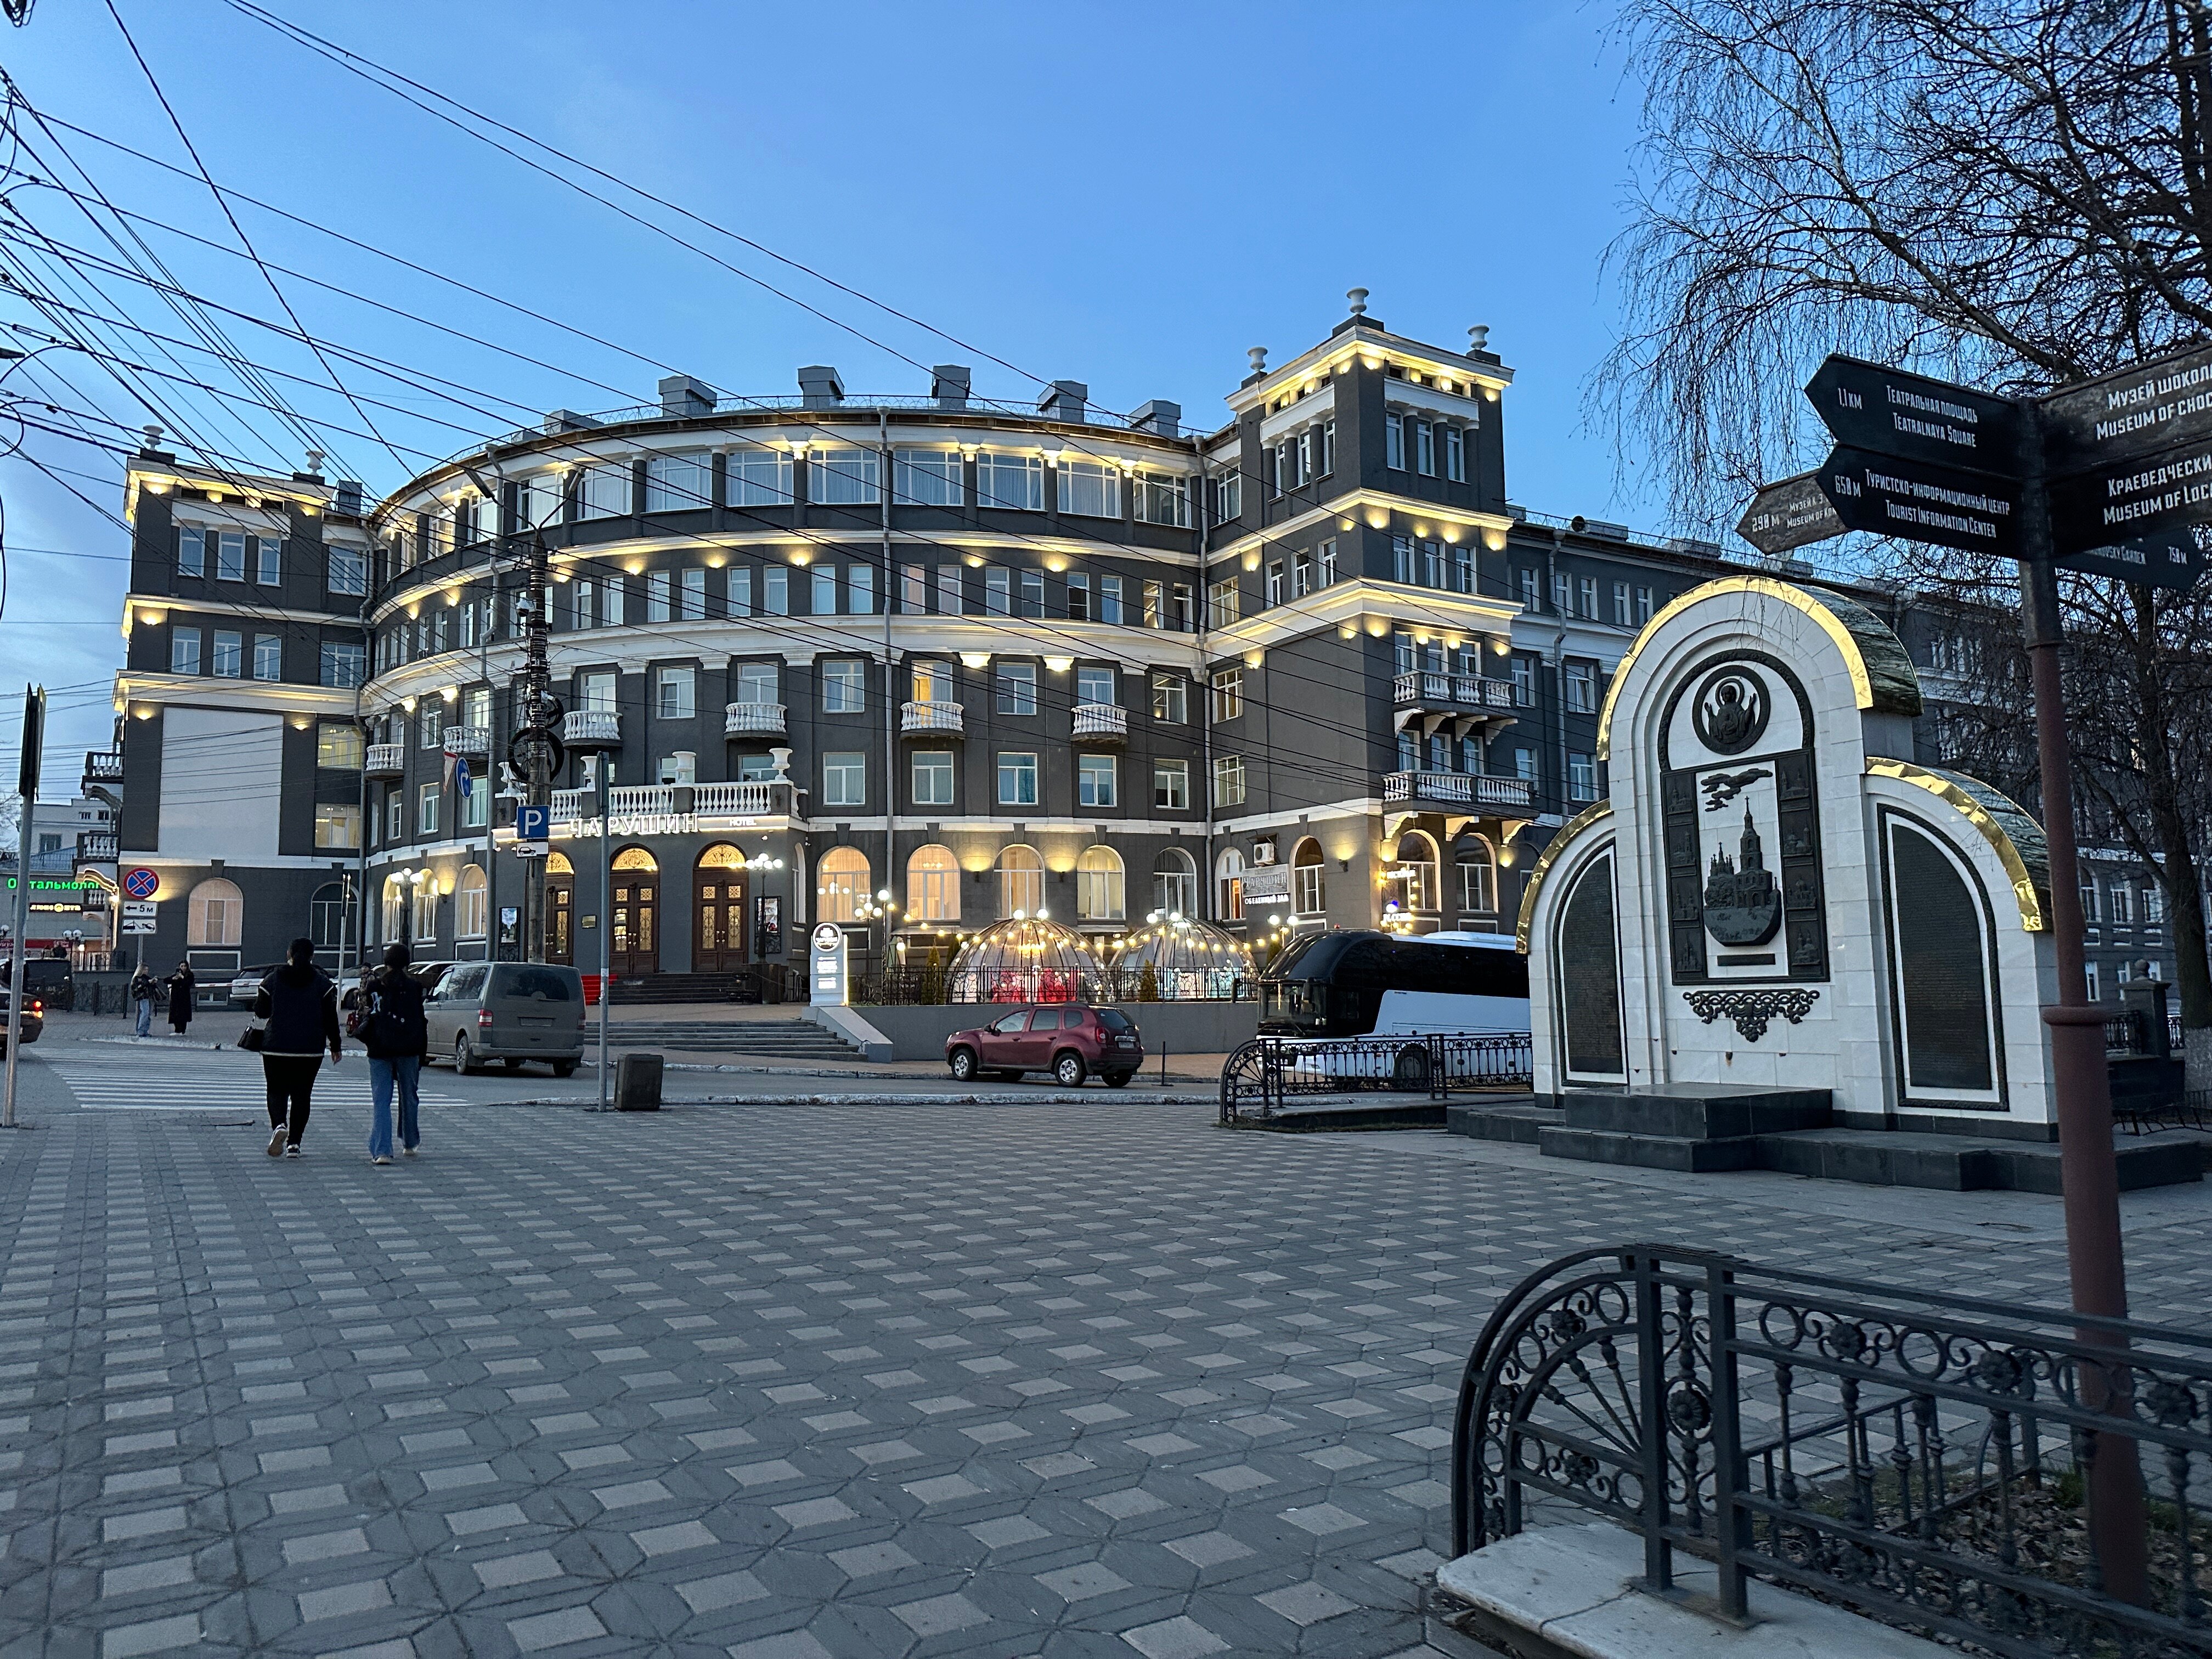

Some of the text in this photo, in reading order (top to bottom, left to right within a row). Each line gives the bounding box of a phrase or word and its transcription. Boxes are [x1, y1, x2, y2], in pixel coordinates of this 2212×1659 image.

[2108, 380, 2155, 410] МУЗЕЙ
[1893, 413, 1976, 447] TEATRALNAYA SQUARE
[2096, 410, 2155, 440] MUSEUM
[1835, 475, 1851, 495] 650
[1789, 497, 1811, 512] МУЗЕЙ
[2103, 496, 2162, 525] MUSEUM
[2183, 483, 2212, 504] LOC
[1752, 513, 1769, 532] 290
[1787, 513, 1814, 528] MUSEUM
[1886, 500, 1996, 538] TOURIST INFORMATION CENTER
[525, 810, 542, 834] P
[567, 812, 698, 838] ЧАРУШИН
[8, 878, 99, 890] Отальмолог
